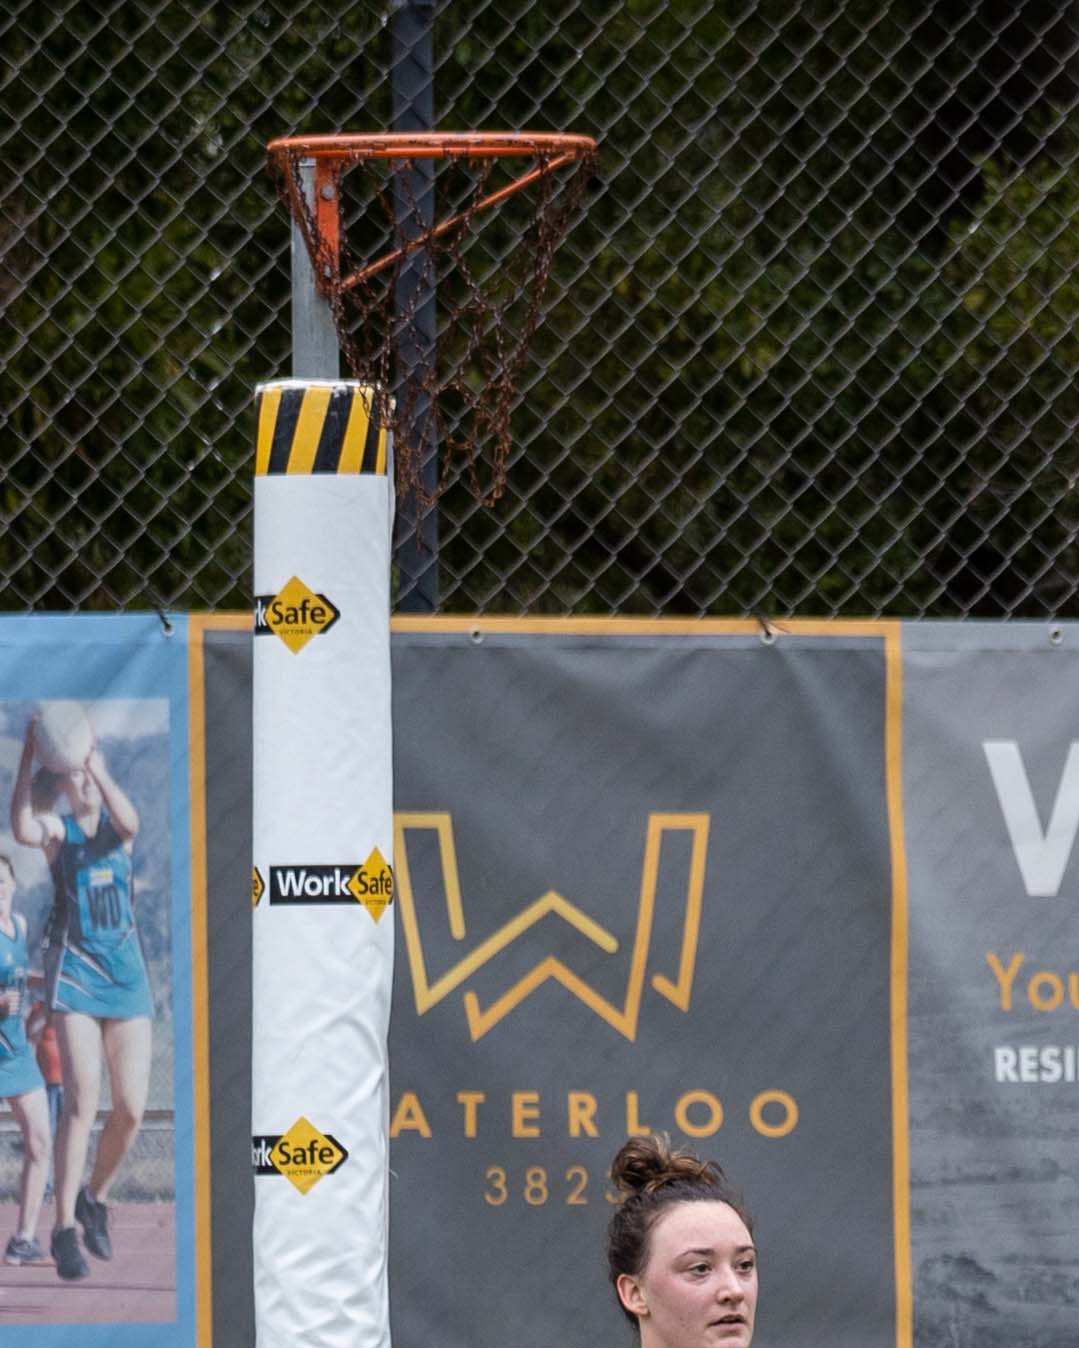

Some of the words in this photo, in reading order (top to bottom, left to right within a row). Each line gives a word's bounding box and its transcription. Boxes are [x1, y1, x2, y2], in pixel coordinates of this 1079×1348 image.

[277, 869, 392, 896] WorkSafe
[389, 1090, 799, 1138] ATERLOO
[483, 1165, 626, 1206] 382
